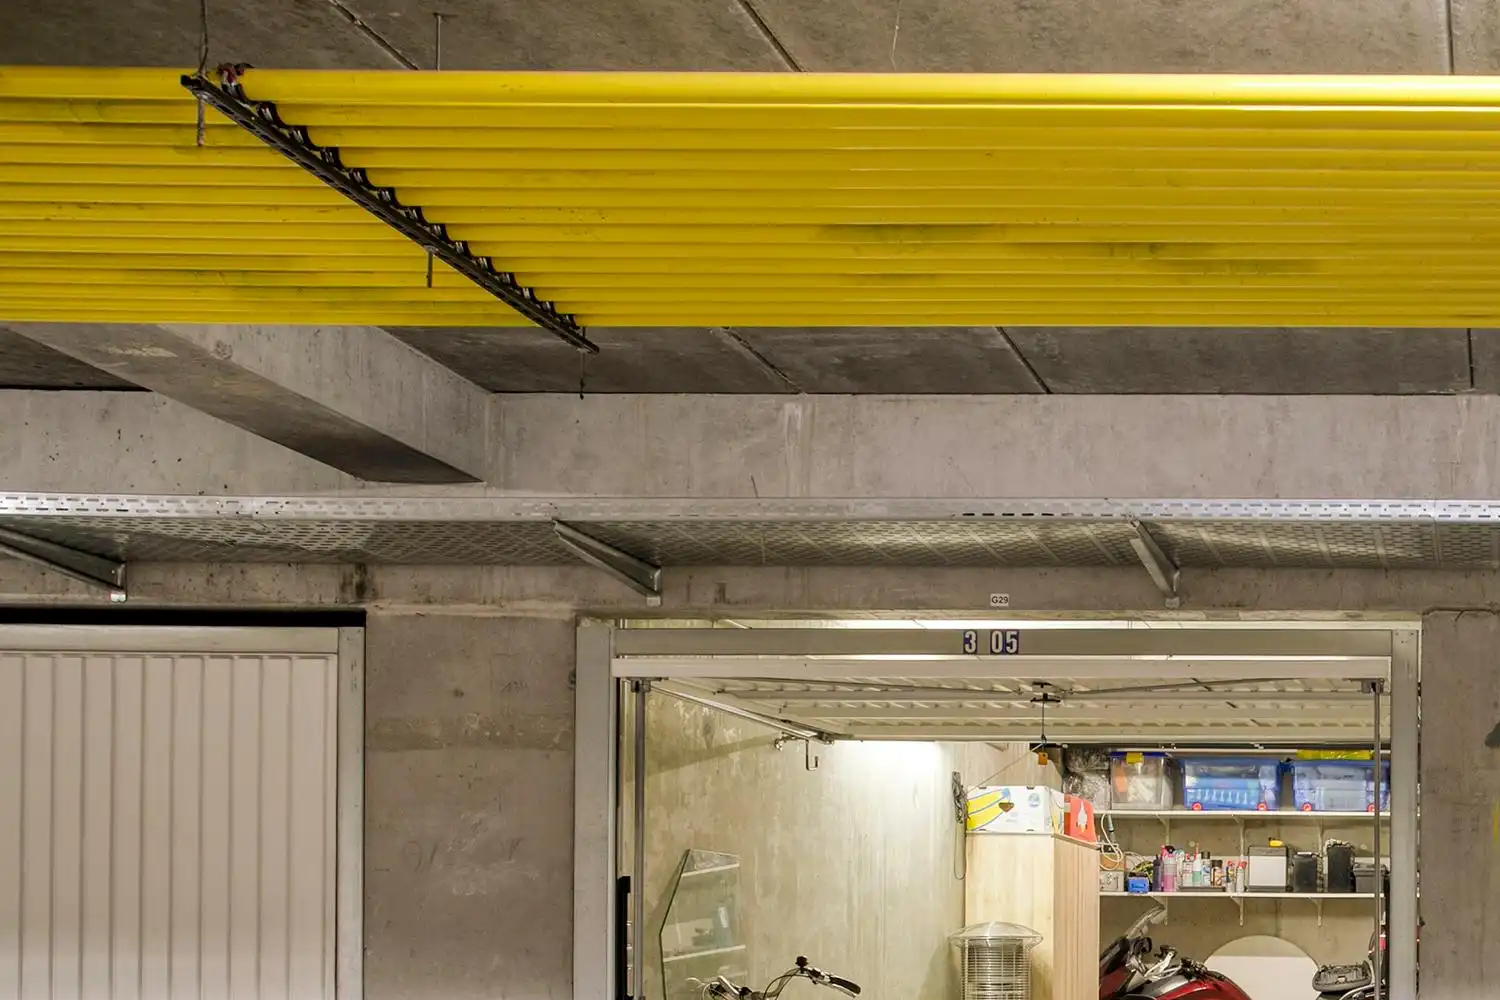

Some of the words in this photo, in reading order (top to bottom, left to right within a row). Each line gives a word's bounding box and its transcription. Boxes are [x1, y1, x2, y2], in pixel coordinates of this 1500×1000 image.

[991, 596, 1009, 605] G29
[964, 630, 977, 654] 3
[991, 630, 1018, 654] 05
